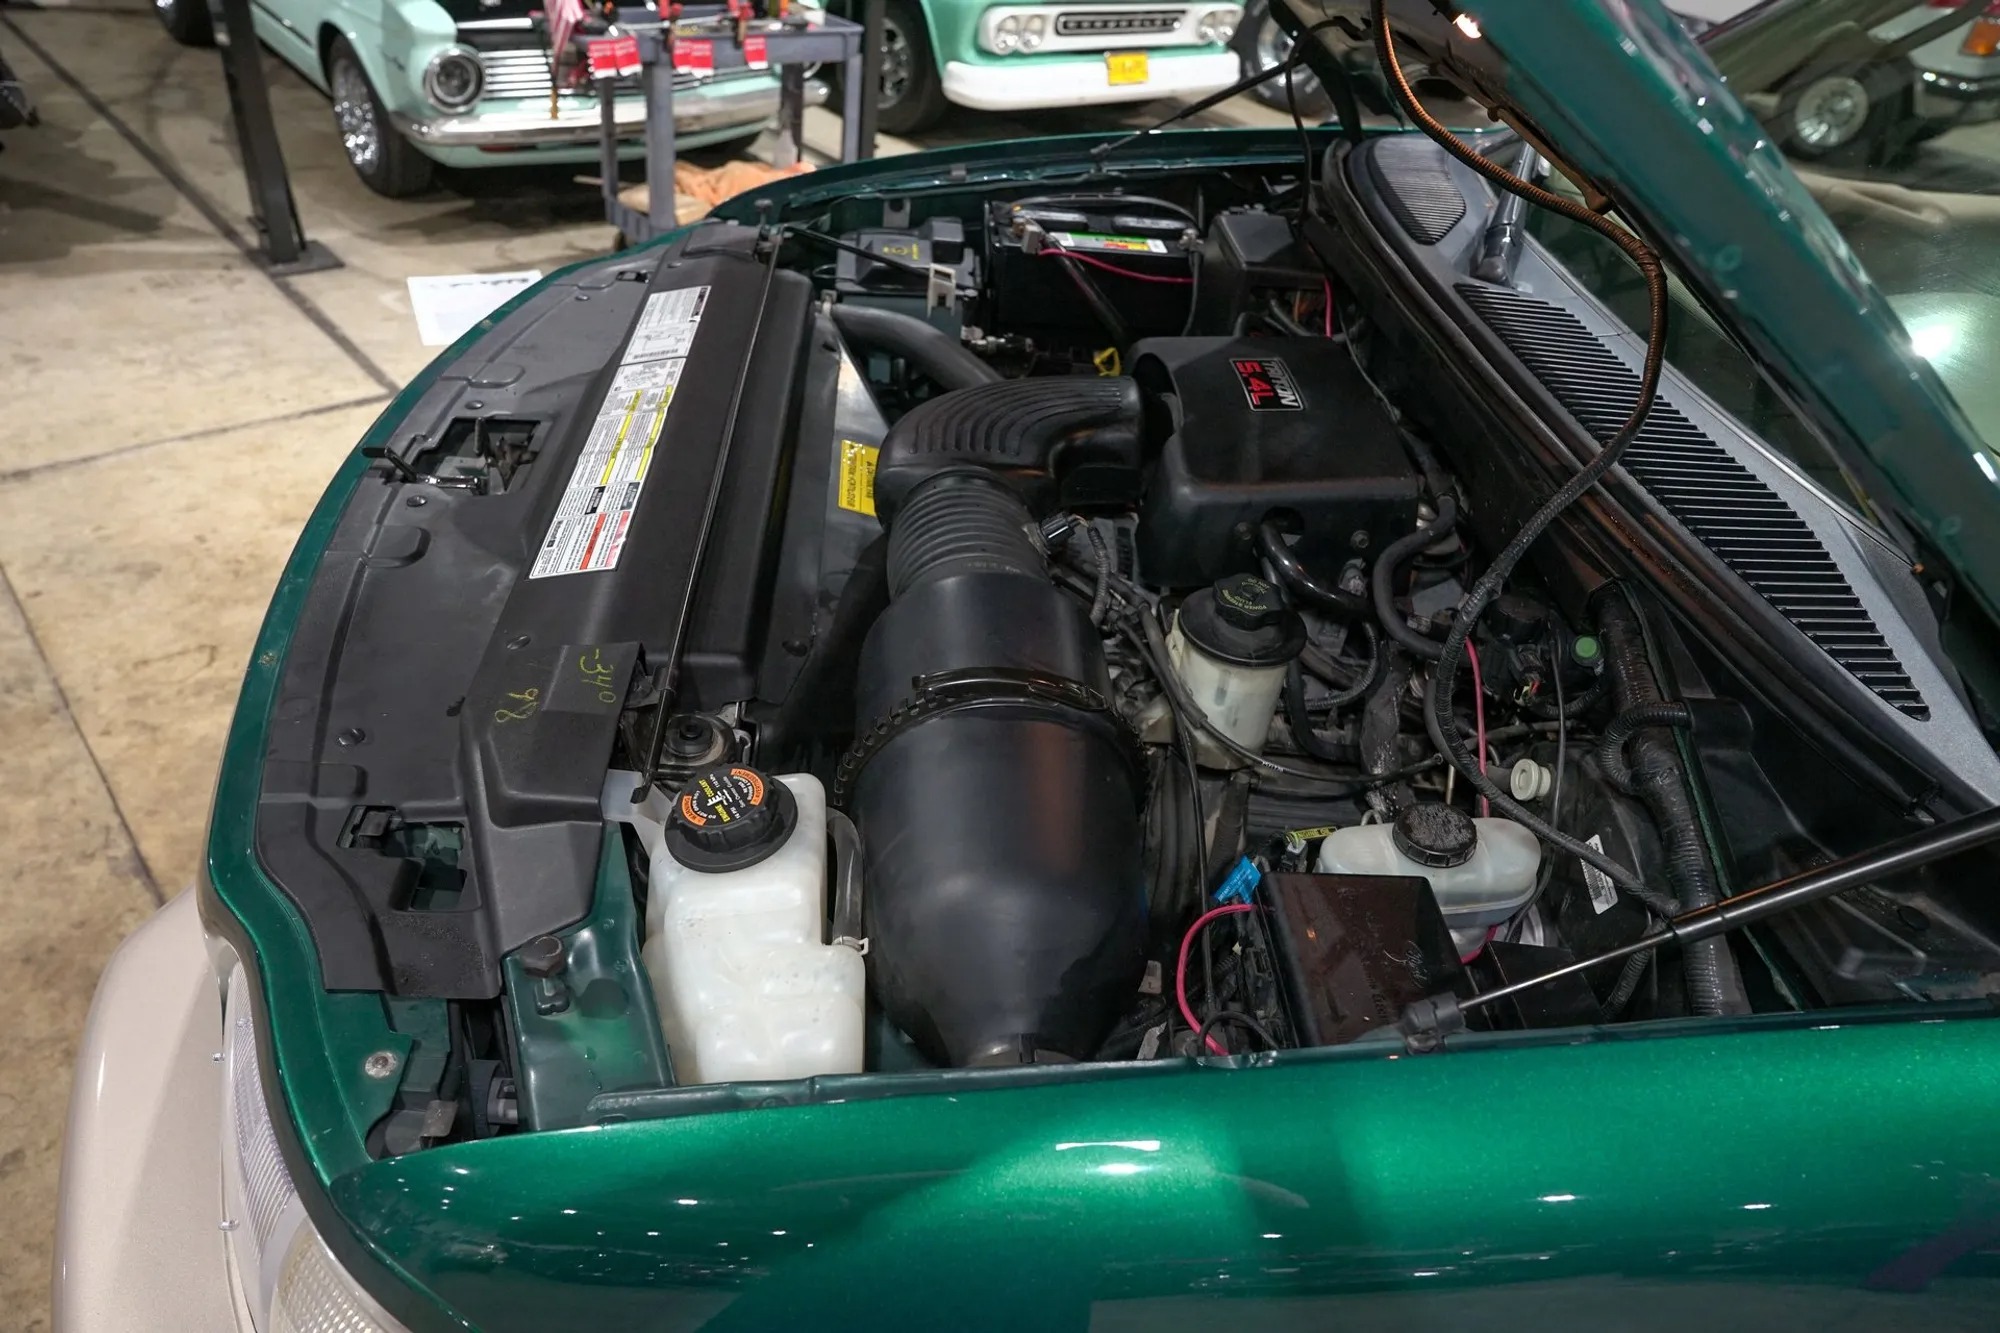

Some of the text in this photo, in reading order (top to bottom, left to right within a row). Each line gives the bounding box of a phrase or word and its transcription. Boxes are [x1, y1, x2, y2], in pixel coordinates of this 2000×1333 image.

[1236, 361, 1274, 405] 5.4L
[1262, 360, 1299, 407] TRITON
[699, 779, 730, 822] ENGINE COOLANT
